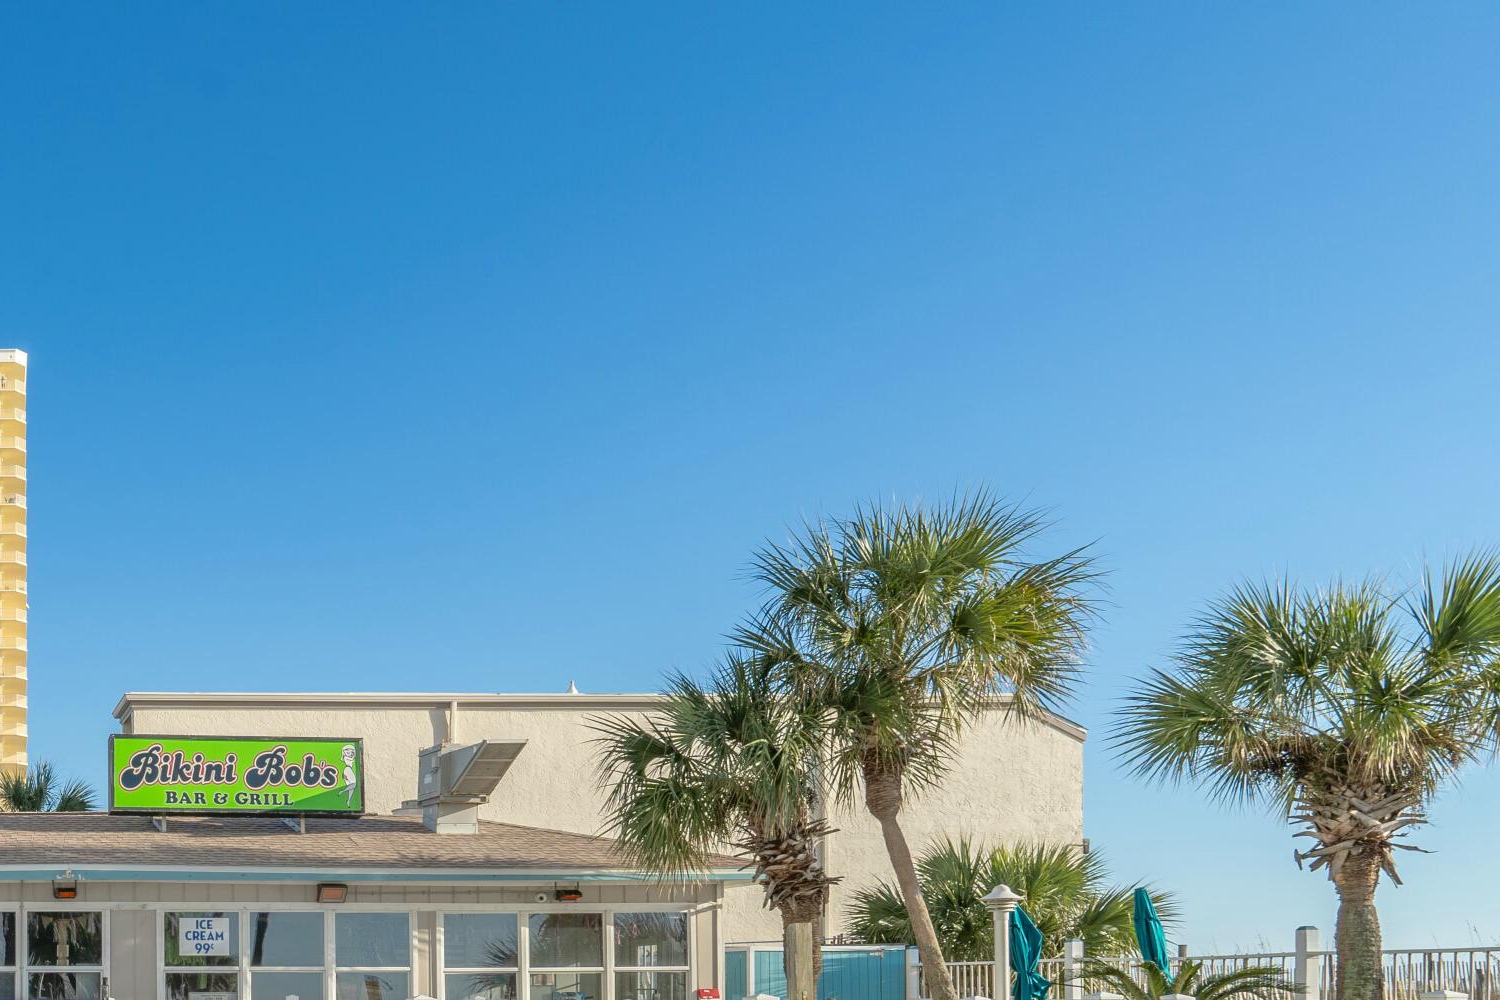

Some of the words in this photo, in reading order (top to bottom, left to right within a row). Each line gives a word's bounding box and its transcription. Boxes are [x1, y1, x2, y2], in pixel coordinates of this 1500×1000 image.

[120, 744, 238, 791] Bikini
[245, 745, 338, 789] Bob's
[165, 791, 206, 805] BAR
[213, 792, 228, 805] &
[235, 792, 294, 806] GRILL
[195, 919, 213, 930] ICE
[185, 930, 224, 941] CREAM
